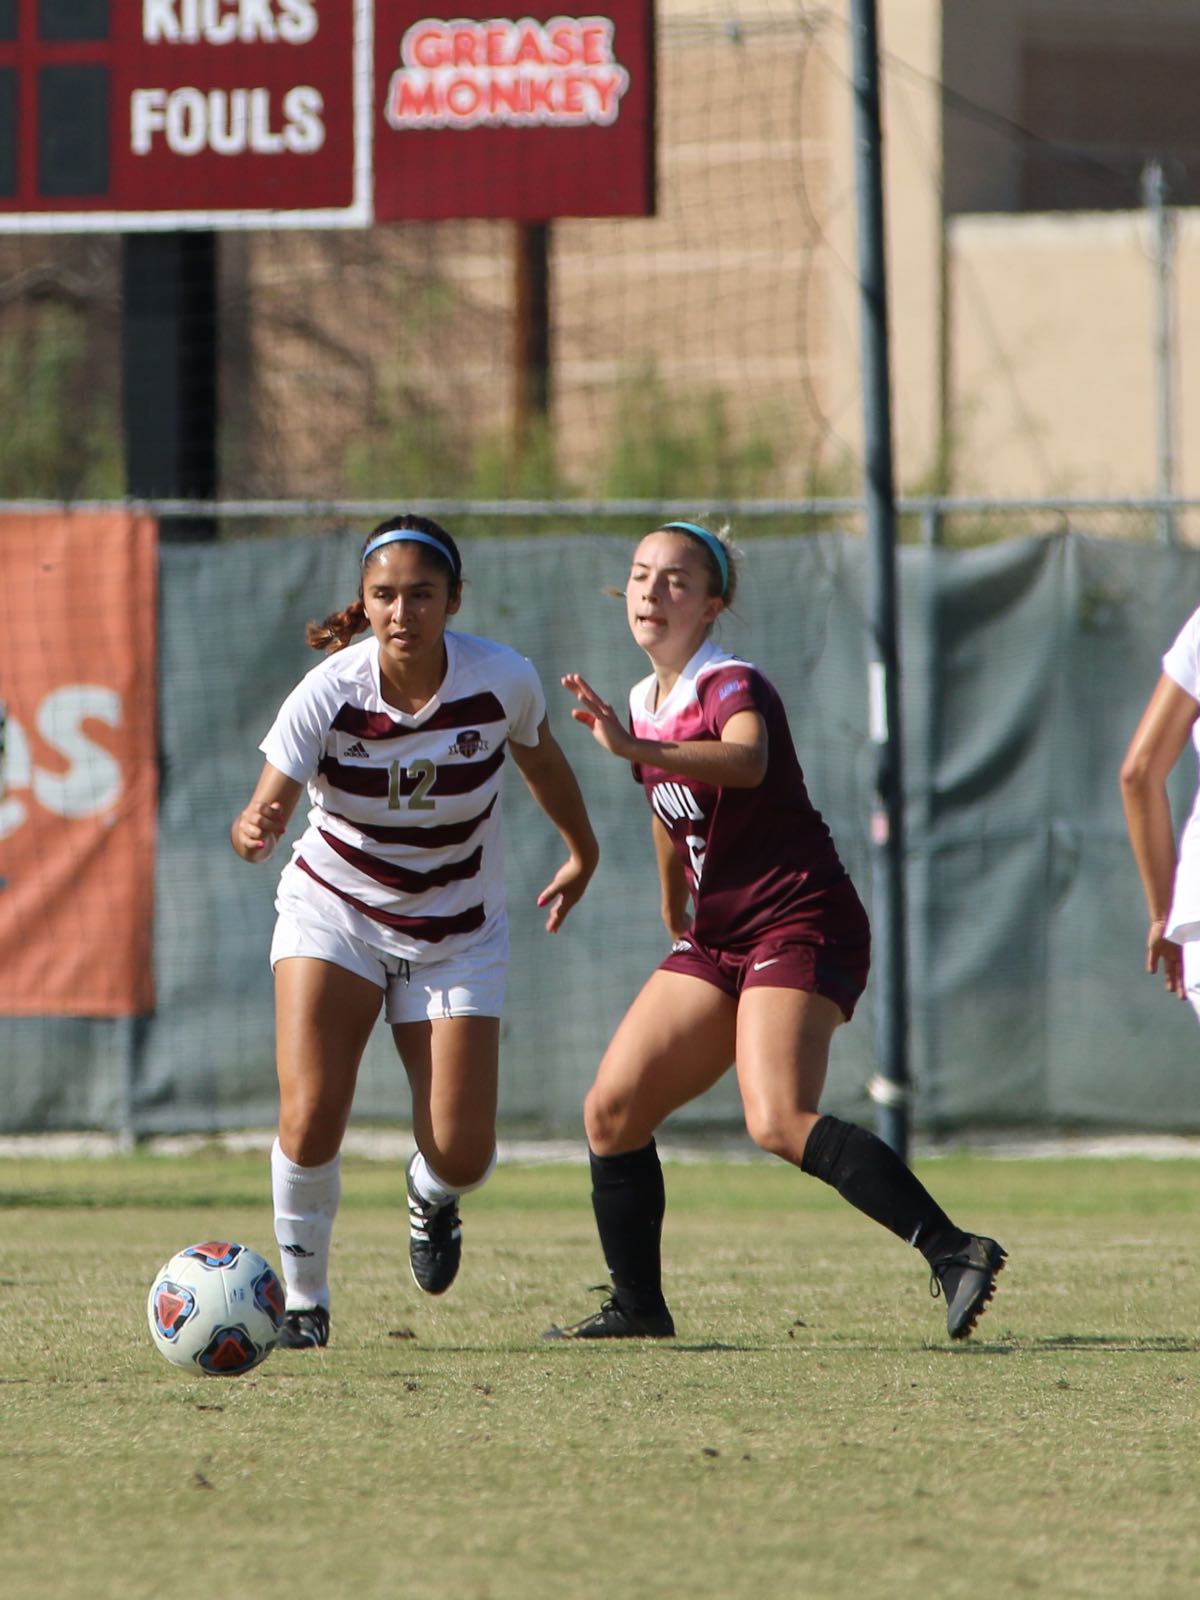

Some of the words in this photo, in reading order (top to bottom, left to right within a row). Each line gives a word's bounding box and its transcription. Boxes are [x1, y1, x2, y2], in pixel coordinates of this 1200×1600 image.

[142, 0, 318, 45] KICKS
[410, 26, 606, 68] GREASE
[394, 74, 623, 119] MONKEY
[131, 86, 325, 155] FOULS
[387, 758, 437, 810] 12
